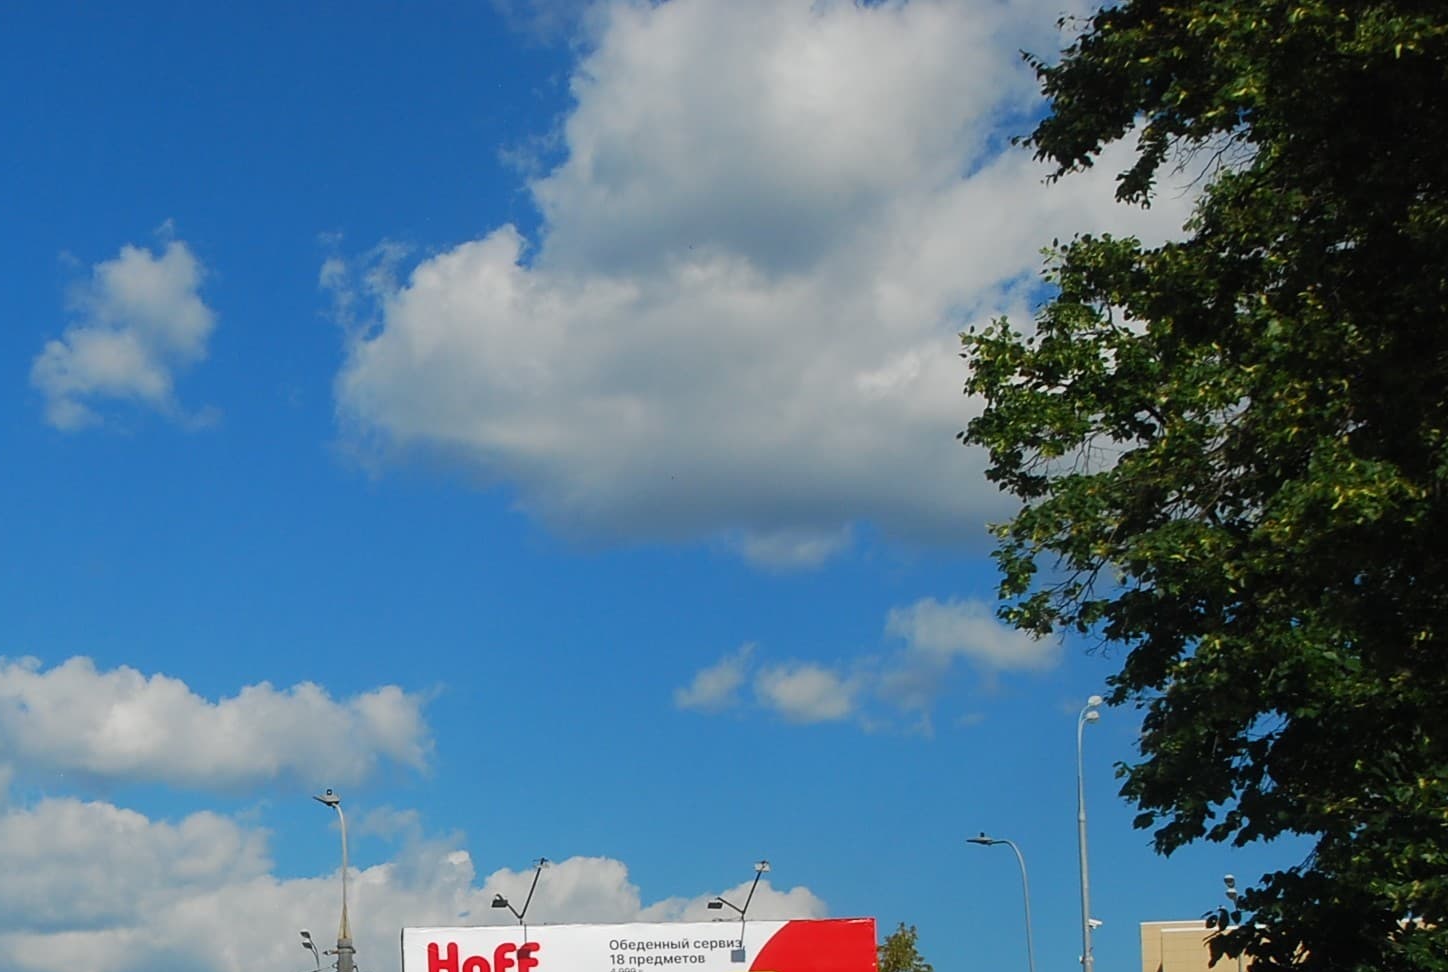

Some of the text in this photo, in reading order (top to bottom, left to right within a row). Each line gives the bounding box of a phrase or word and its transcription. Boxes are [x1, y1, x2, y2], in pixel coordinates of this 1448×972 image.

[609, 937, 742, 951] Обеденный сервиз
[610, 953, 706, 967] 18 предметов
